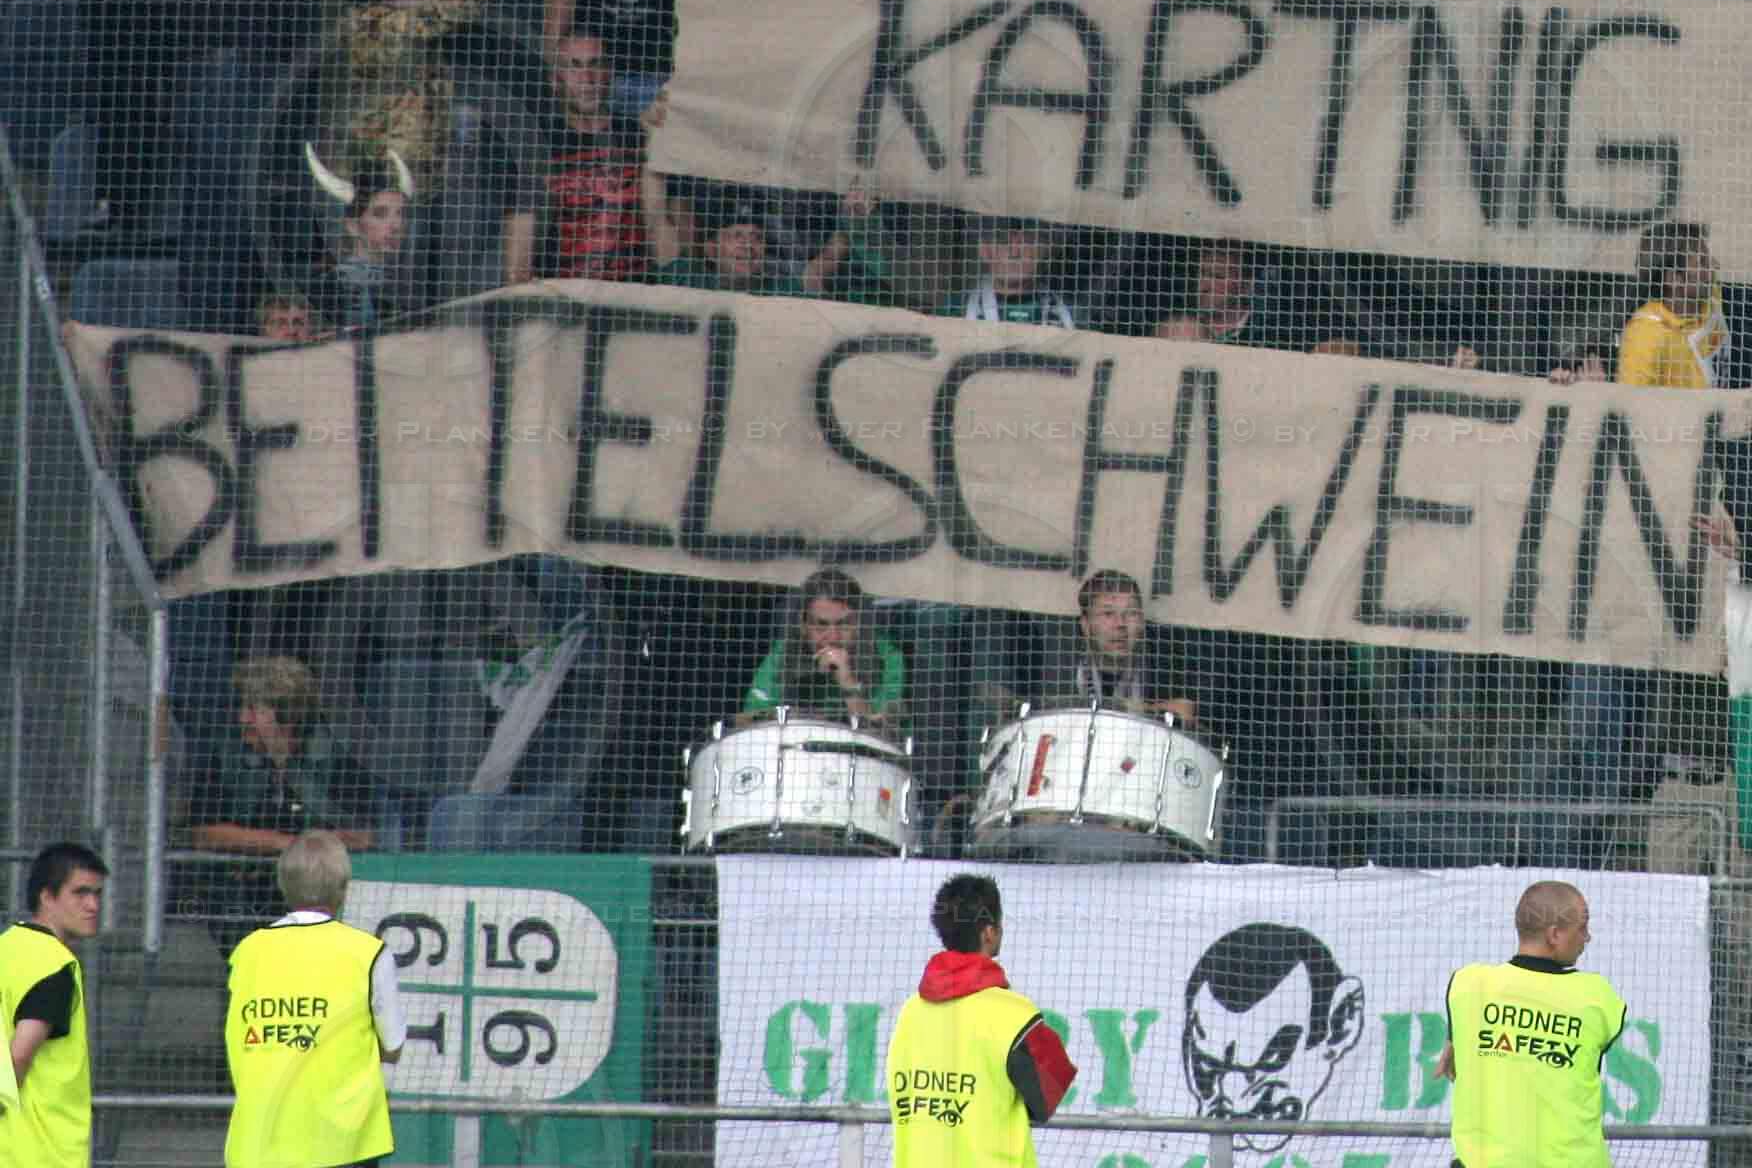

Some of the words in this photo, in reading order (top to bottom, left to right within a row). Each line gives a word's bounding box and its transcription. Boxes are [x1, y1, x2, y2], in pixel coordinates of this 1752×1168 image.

[106, 294, 1720, 642] BETTELSCHWEIN
[1483, 1002, 1583, 1039] ORDNER
[1478, 1030, 1582, 1061] SAFETY
[894, 1069, 977, 1095] ODNER
[1379, 1011, 1664, 1124] BS
[896, 1097, 970, 1119] SFETY
